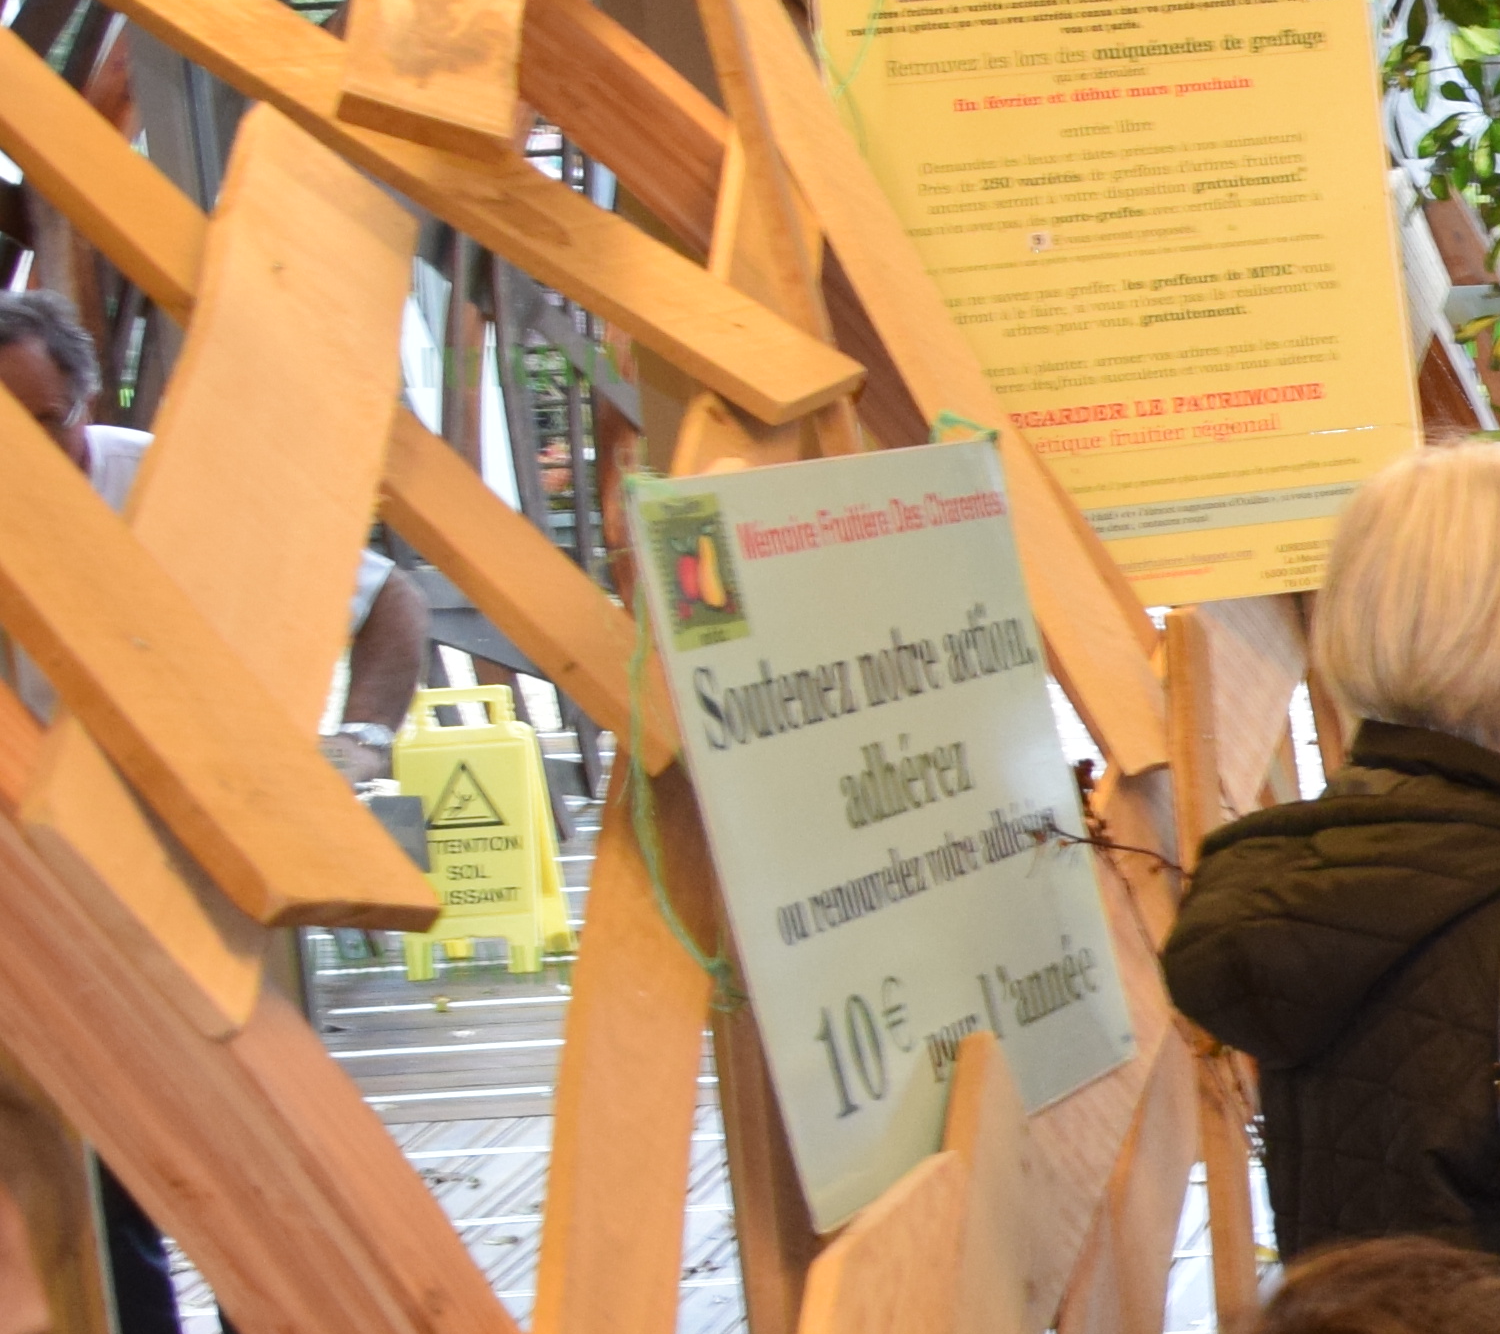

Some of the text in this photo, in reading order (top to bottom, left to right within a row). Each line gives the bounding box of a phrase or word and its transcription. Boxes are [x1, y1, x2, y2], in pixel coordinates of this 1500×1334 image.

[952, 96, 980, 113] fin
[982, 91, 1044, 110] février
[1044, 89, 1068, 105] et
[1125, 83, 1171, 98] mars
[1172, 74, 1253, 97] prochain
[1059, 116, 1155, 139] entrée libre
[1132, 396, 1168, 419] LE
[1169, 382, 1325, 416] PATRIMOINE
[1109, 421, 1188, 447] fruitier
[1188, 412, 1281, 443] régional
[736, 490, 1008, 561] Mémoire Fruitière Des Charentes
[691, 601, 1040, 752] Soutenez notre action,
[840, 733, 975, 830] adhérez
[428, 834, 524, 854] TENTION
[446, 864, 490, 881] SOL
[777, 898, 810, 946] ou
[807, 848, 929, 933] renouvelez
[926, 831, 980, 885] votre
[976, 934, 1101, 1040] l'année
